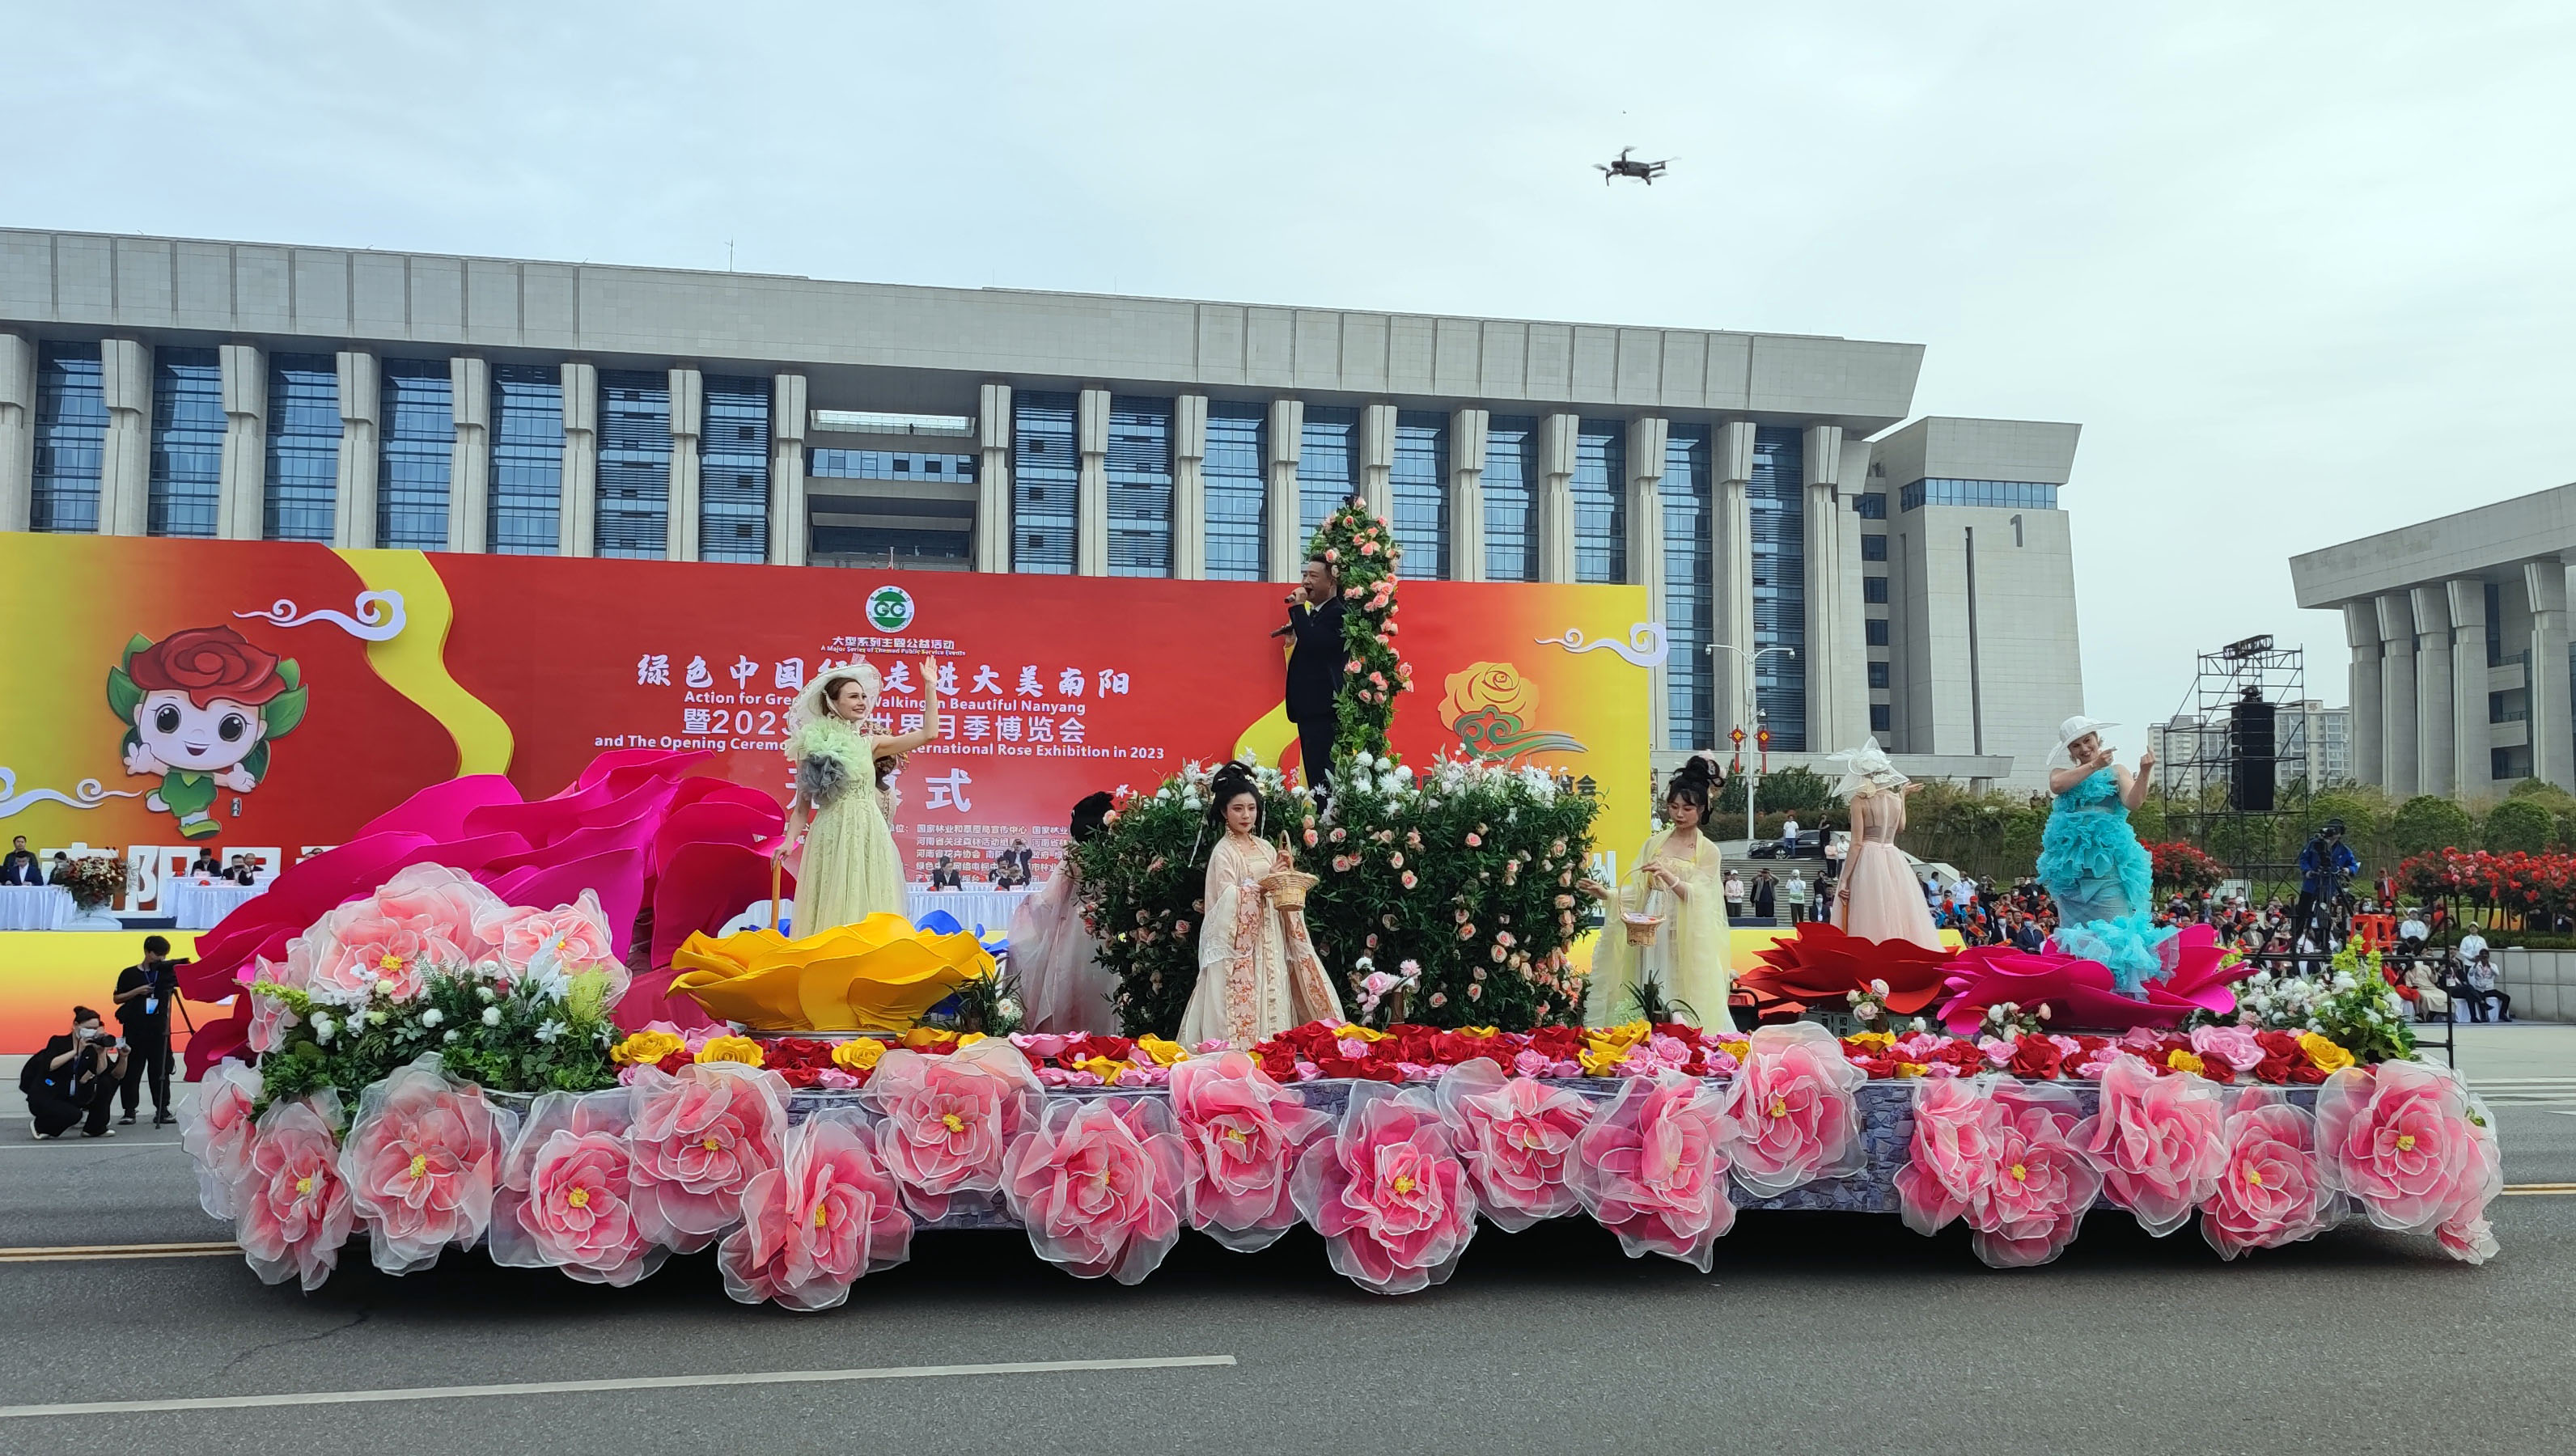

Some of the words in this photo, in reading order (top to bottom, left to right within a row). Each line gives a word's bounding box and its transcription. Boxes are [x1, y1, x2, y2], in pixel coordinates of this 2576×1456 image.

[2010, 514, 2024, 548] 1
[832, 636, 955, 650] 大型系列主题公益活动
[638, 654, 1130, 699] 绿色中国走进大美南阳
[684, 690, 735, 705] Action
[739, 692, 762, 705] for
[765, 693, 792, 705] Gre
[950, 697, 1017, 712] Beautiful
[1021, 700, 1086, 716] Nanyang
[595, 734, 624, 747] and
[627, 734, 657, 747] The
[660, 735, 726, 752] Opening
[730, 737, 787, 751] Ceremo
[998, 743, 1032, 756] Rose
[1036, 744, 1110, 758] Exhibition
[1113, 746, 1127, 758] in
[1129, 747, 1164, 760] 2023
